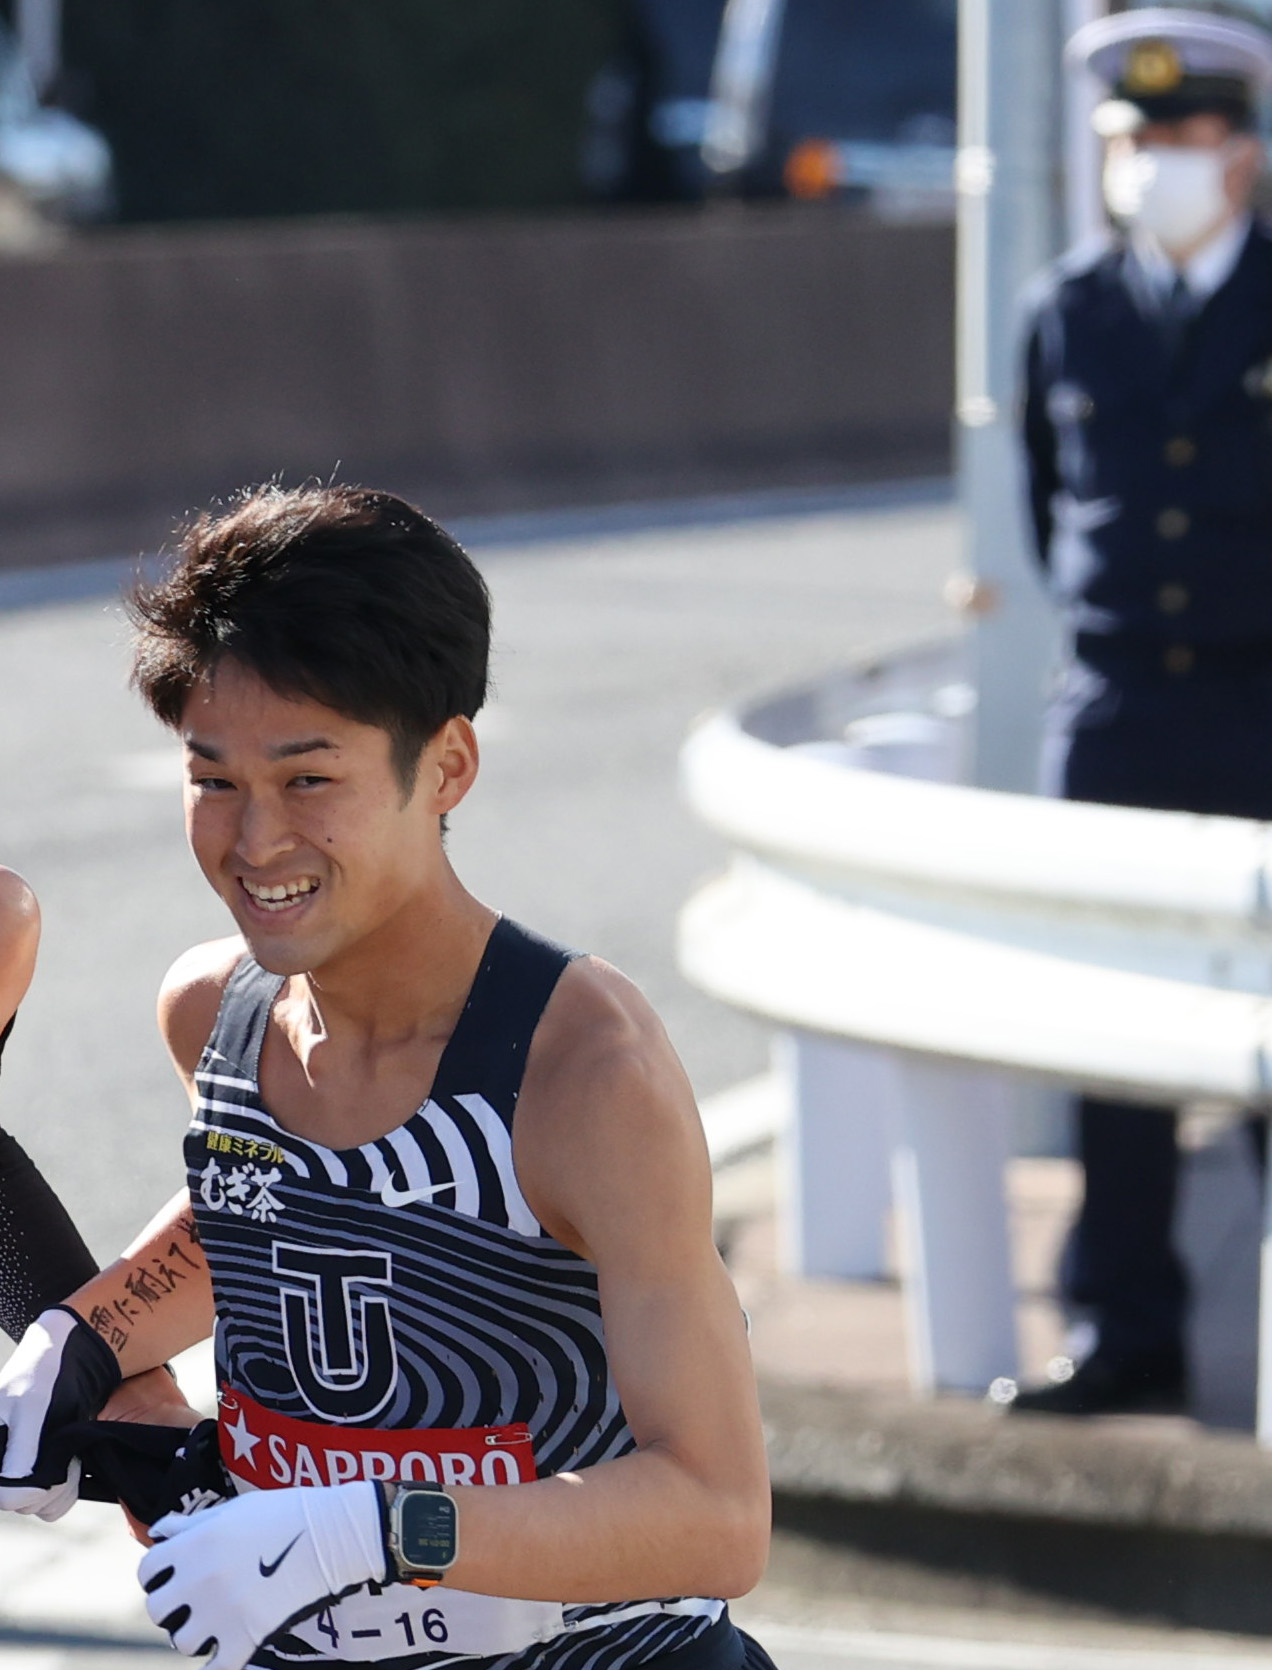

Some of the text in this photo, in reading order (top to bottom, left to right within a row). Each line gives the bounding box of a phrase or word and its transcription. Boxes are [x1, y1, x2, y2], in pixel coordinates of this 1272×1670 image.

[207, 1131, 284, 1165] 健康ミネラル
[200, 1156, 286, 1223] むぎ茶
